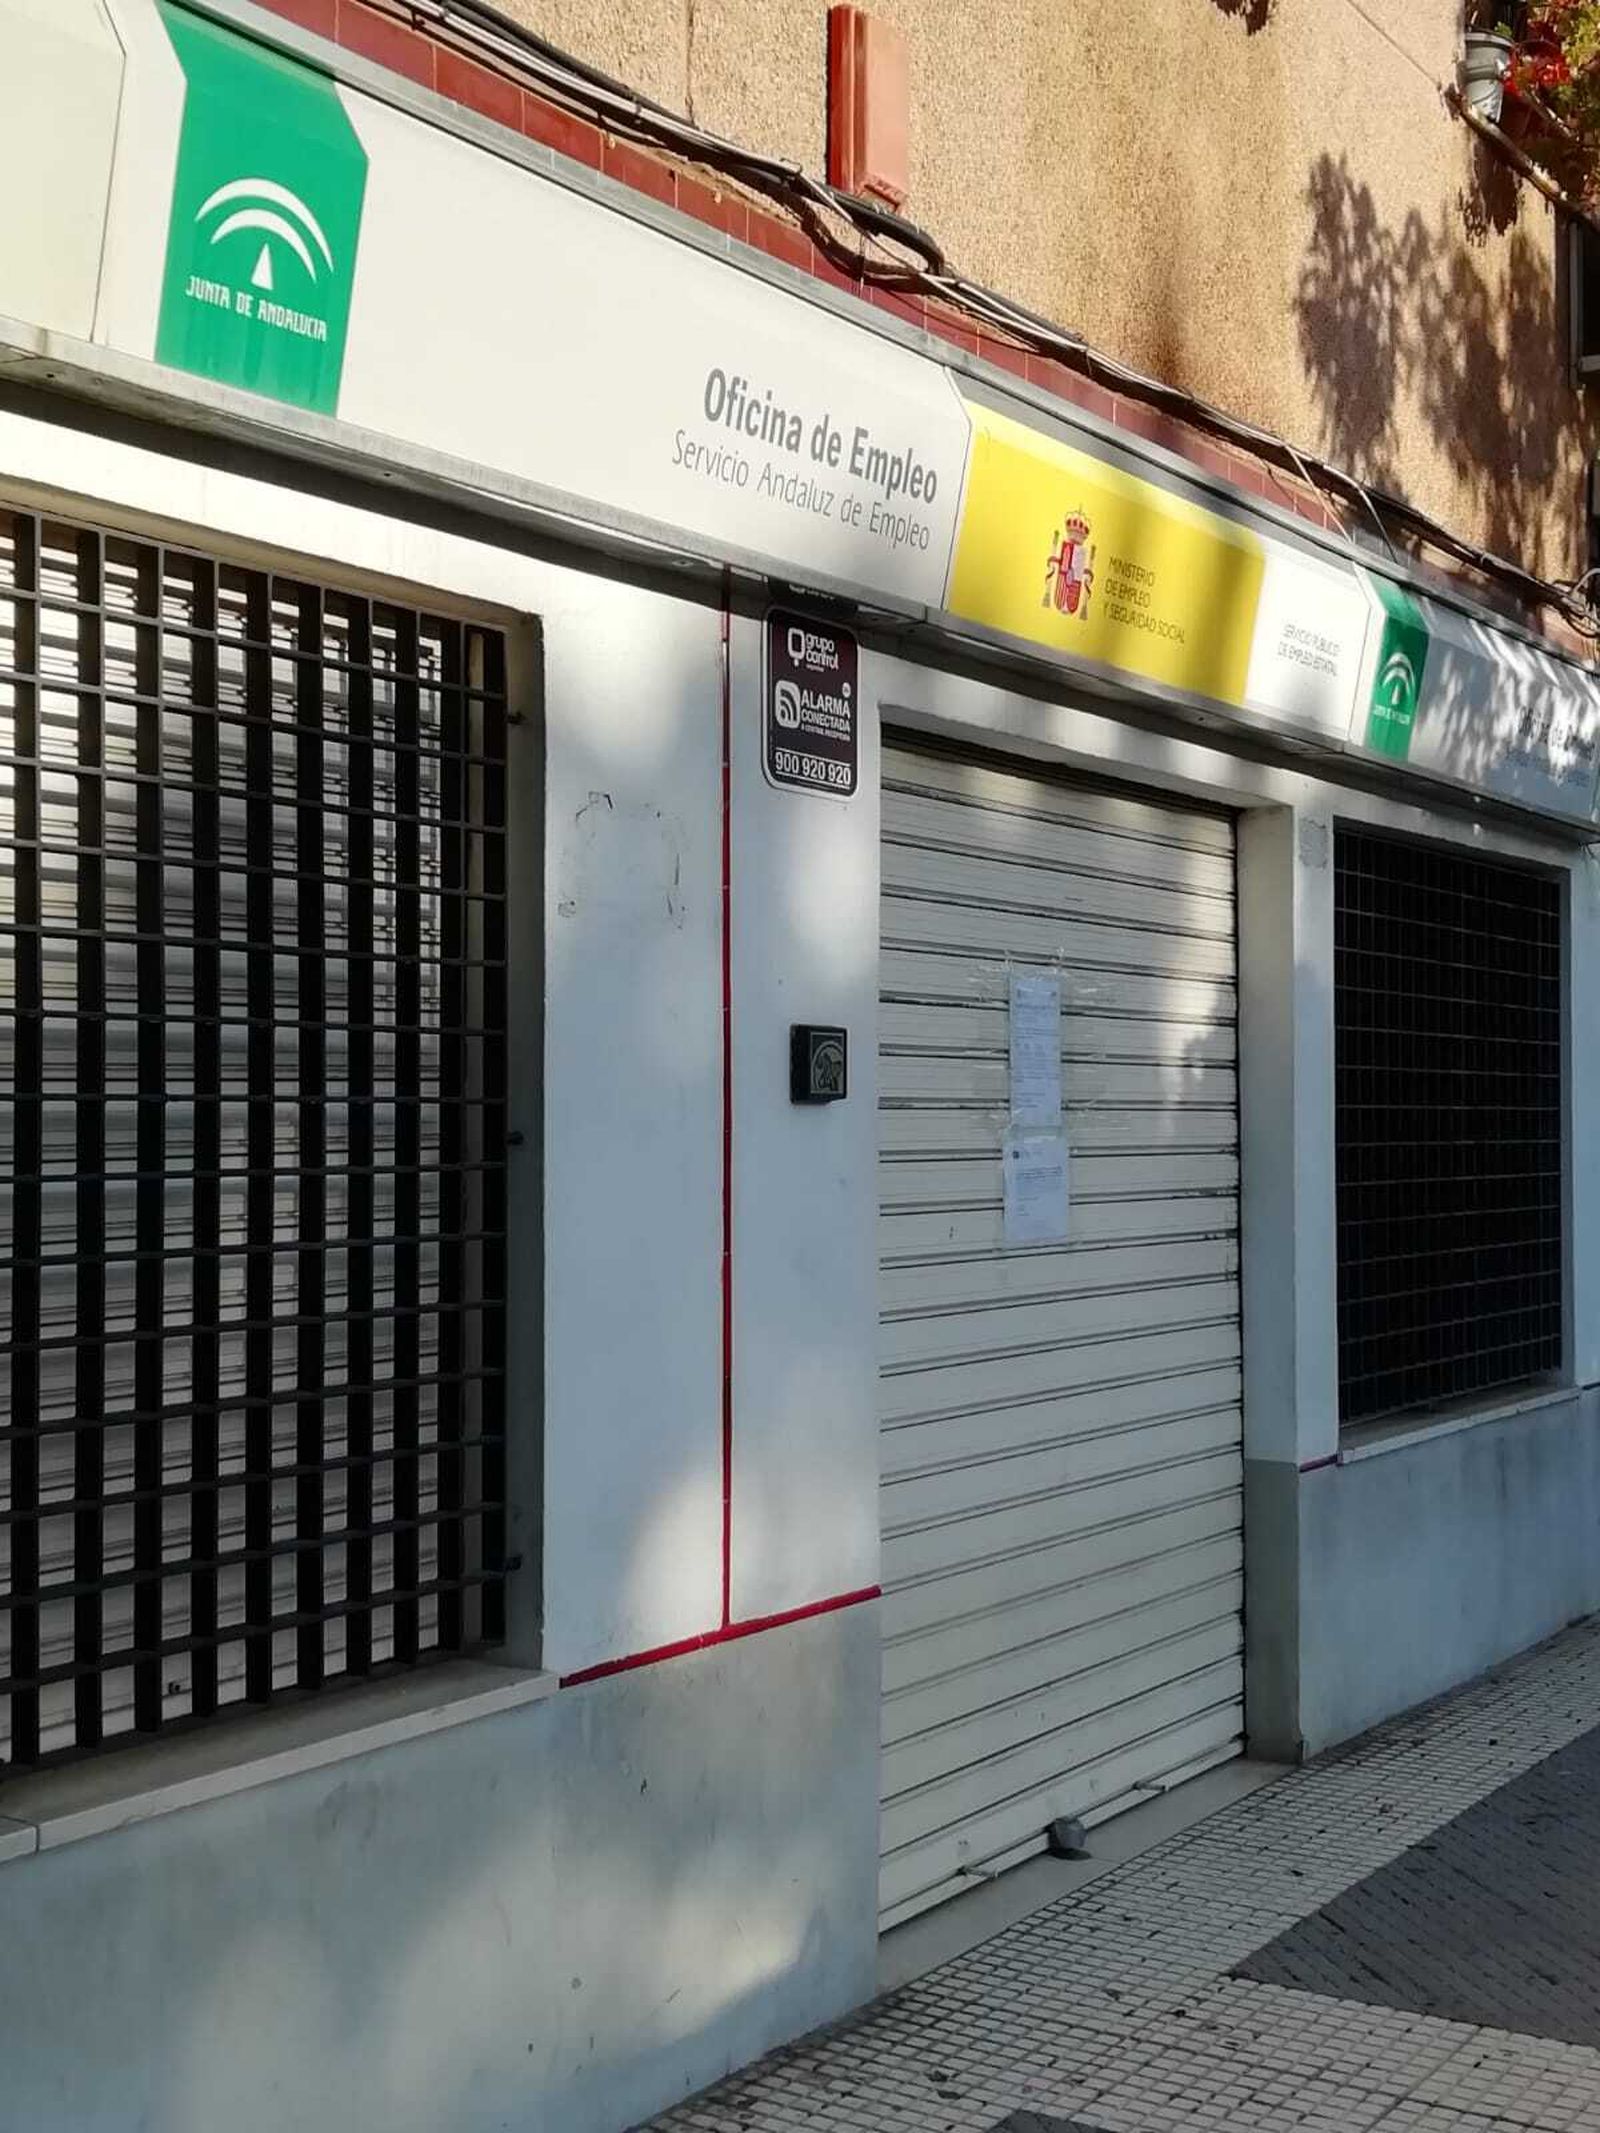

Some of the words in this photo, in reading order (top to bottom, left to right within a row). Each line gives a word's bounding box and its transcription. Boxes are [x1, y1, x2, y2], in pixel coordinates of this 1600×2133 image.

[185, 275, 231, 310] JUNTA
[235, 291, 254, 317] DE
[257, 299, 328, 342] ANDALUCIA
[704, 368, 803, 454] Oficina
[810, 414, 842, 468] de
[849, 426, 938, 504] Empleo
[671, 428, 750, 487] Servicio
[757, 462, 835, 518] Andaluz
[840, 495, 863, 528] de
[868, 501, 930, 551] Empleo
[1108, 556, 1155, 587] MINISTERIO
[1118, 582, 1151, 609] EMPLEO
[805, 633, 835, 653] grupo
[805, 649, 839, 670] control
[801, 689, 851, 719] ALARMA
[801, 708, 851, 732] CONECTADA
[775, 751, 800, 775] 900
[802, 757, 826, 781] 920
[827, 763, 851, 786] 920
